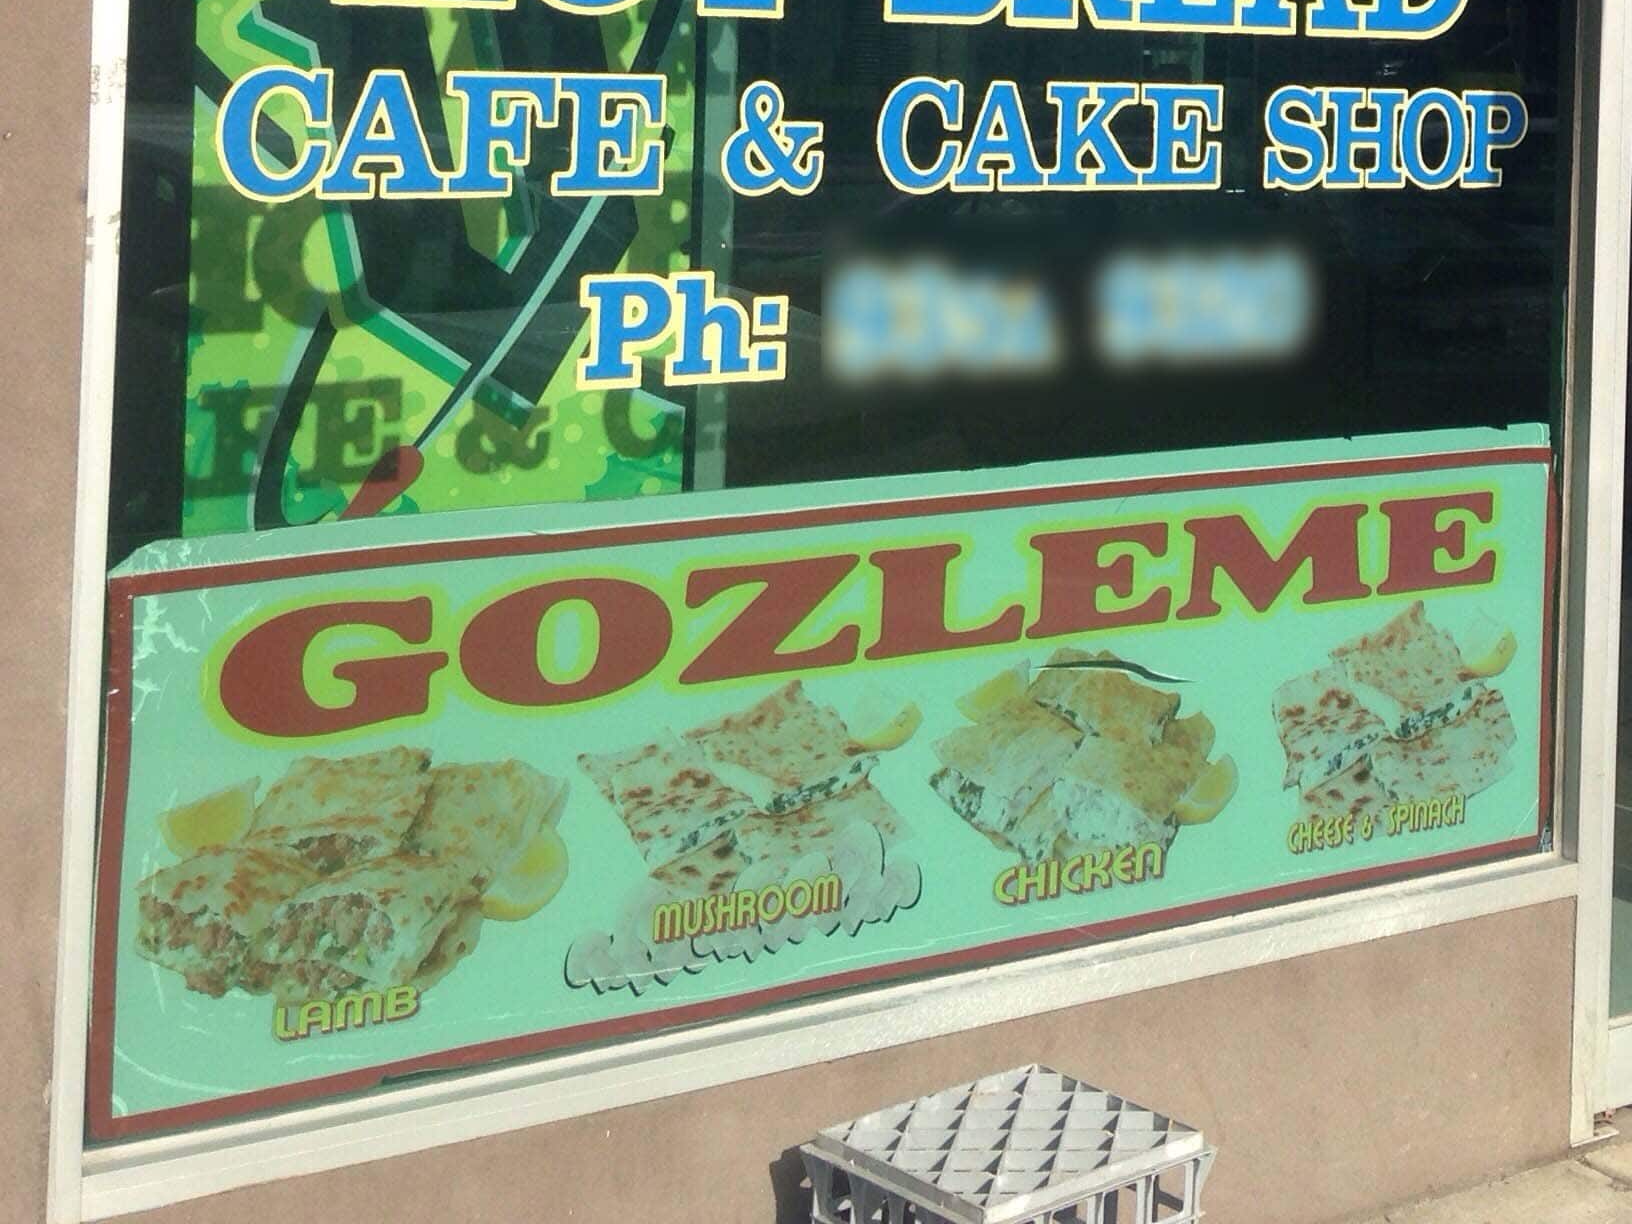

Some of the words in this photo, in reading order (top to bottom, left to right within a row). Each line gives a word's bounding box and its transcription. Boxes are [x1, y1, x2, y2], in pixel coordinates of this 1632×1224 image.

[216, 65, 666, 203] CAFE
[721, 79, 823, 196] &
[876, 76, 1223, 195] CAKE
[1263, 84, 1528, 190] SHOP
[576, 271, 788, 389] Ph:
[218, 490, 1498, 739] GOZLEME
[1287, 815, 1354, 854] CHEESE
[1361, 815, 1374, 842] &
[1388, 793, 1467, 837] SPINACH
[651, 874, 843, 946] MUSHROOM
[994, 842, 1166, 906] CHICKEN
[274, 985, 421, 1043] LAMB
